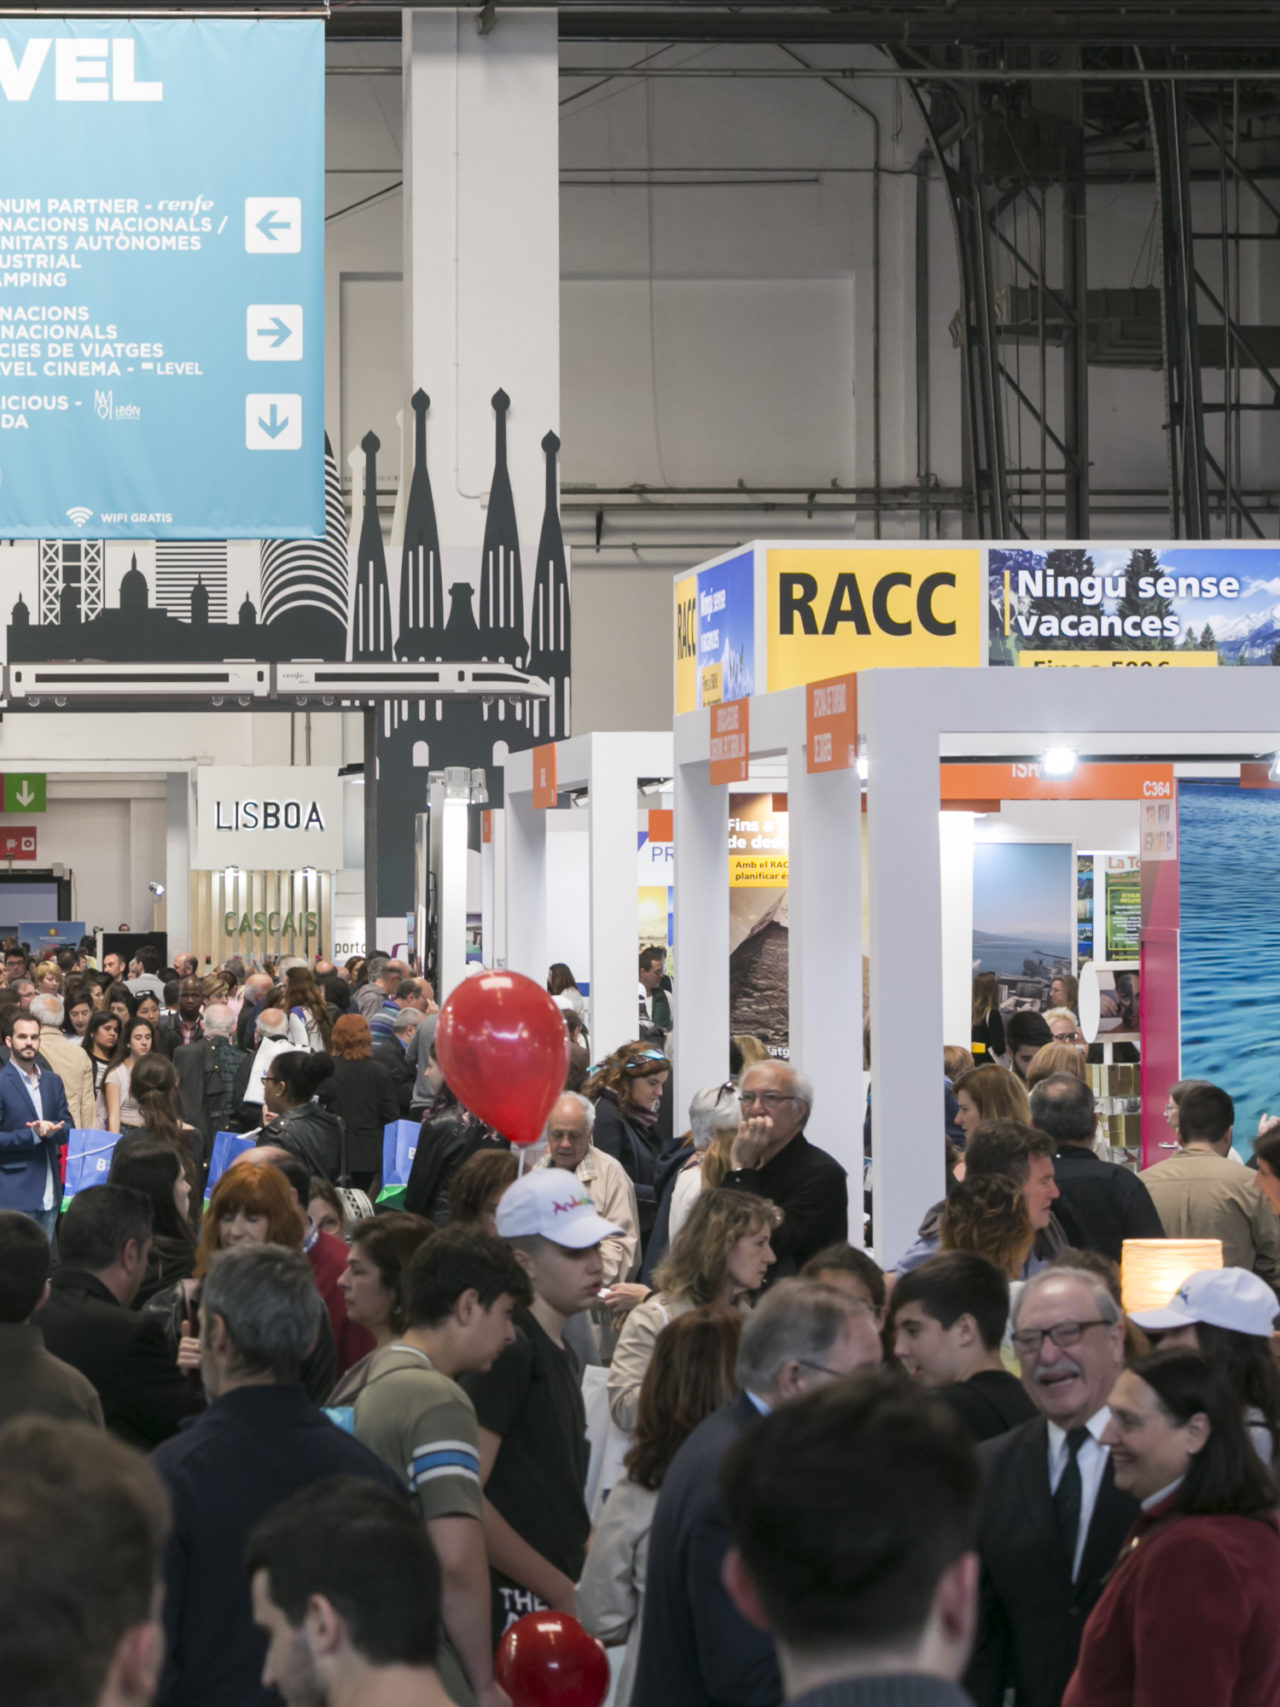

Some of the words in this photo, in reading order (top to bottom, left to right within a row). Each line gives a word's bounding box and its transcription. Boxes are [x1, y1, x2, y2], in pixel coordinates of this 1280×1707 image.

[48, 199, 138, 214] PARTNER
[158, 194, 214, 217] renfe
[96, 217, 212, 232] NACIONALS
[75, 231, 201, 250] AUTÒNOMES
[48, 343, 75, 358] DE
[81, 343, 163, 358] VIATGES
[43, 362, 120, 376] CINEMA
[157, 363, 203, 375] LEVEL
[101, 513, 128, 523] WIFI
[131, 513, 173, 523] GRATIS
[1018, 569, 1126, 605] Ningú
[1137, 574, 1240, 599] sense
[779, 571, 957, 637] RACC
[677, 597, 696, 660] RACC
[1018, 613, 1181, 638] vacances
[1143, 780, 1171, 797] C364
[216, 801, 325, 831] LISBOA
[736, 861, 757, 869] Amb
[1108, 856, 1125, 869] La
[736, 872, 779, 881] planificar
[224, 912, 318, 937] CASCAIS
